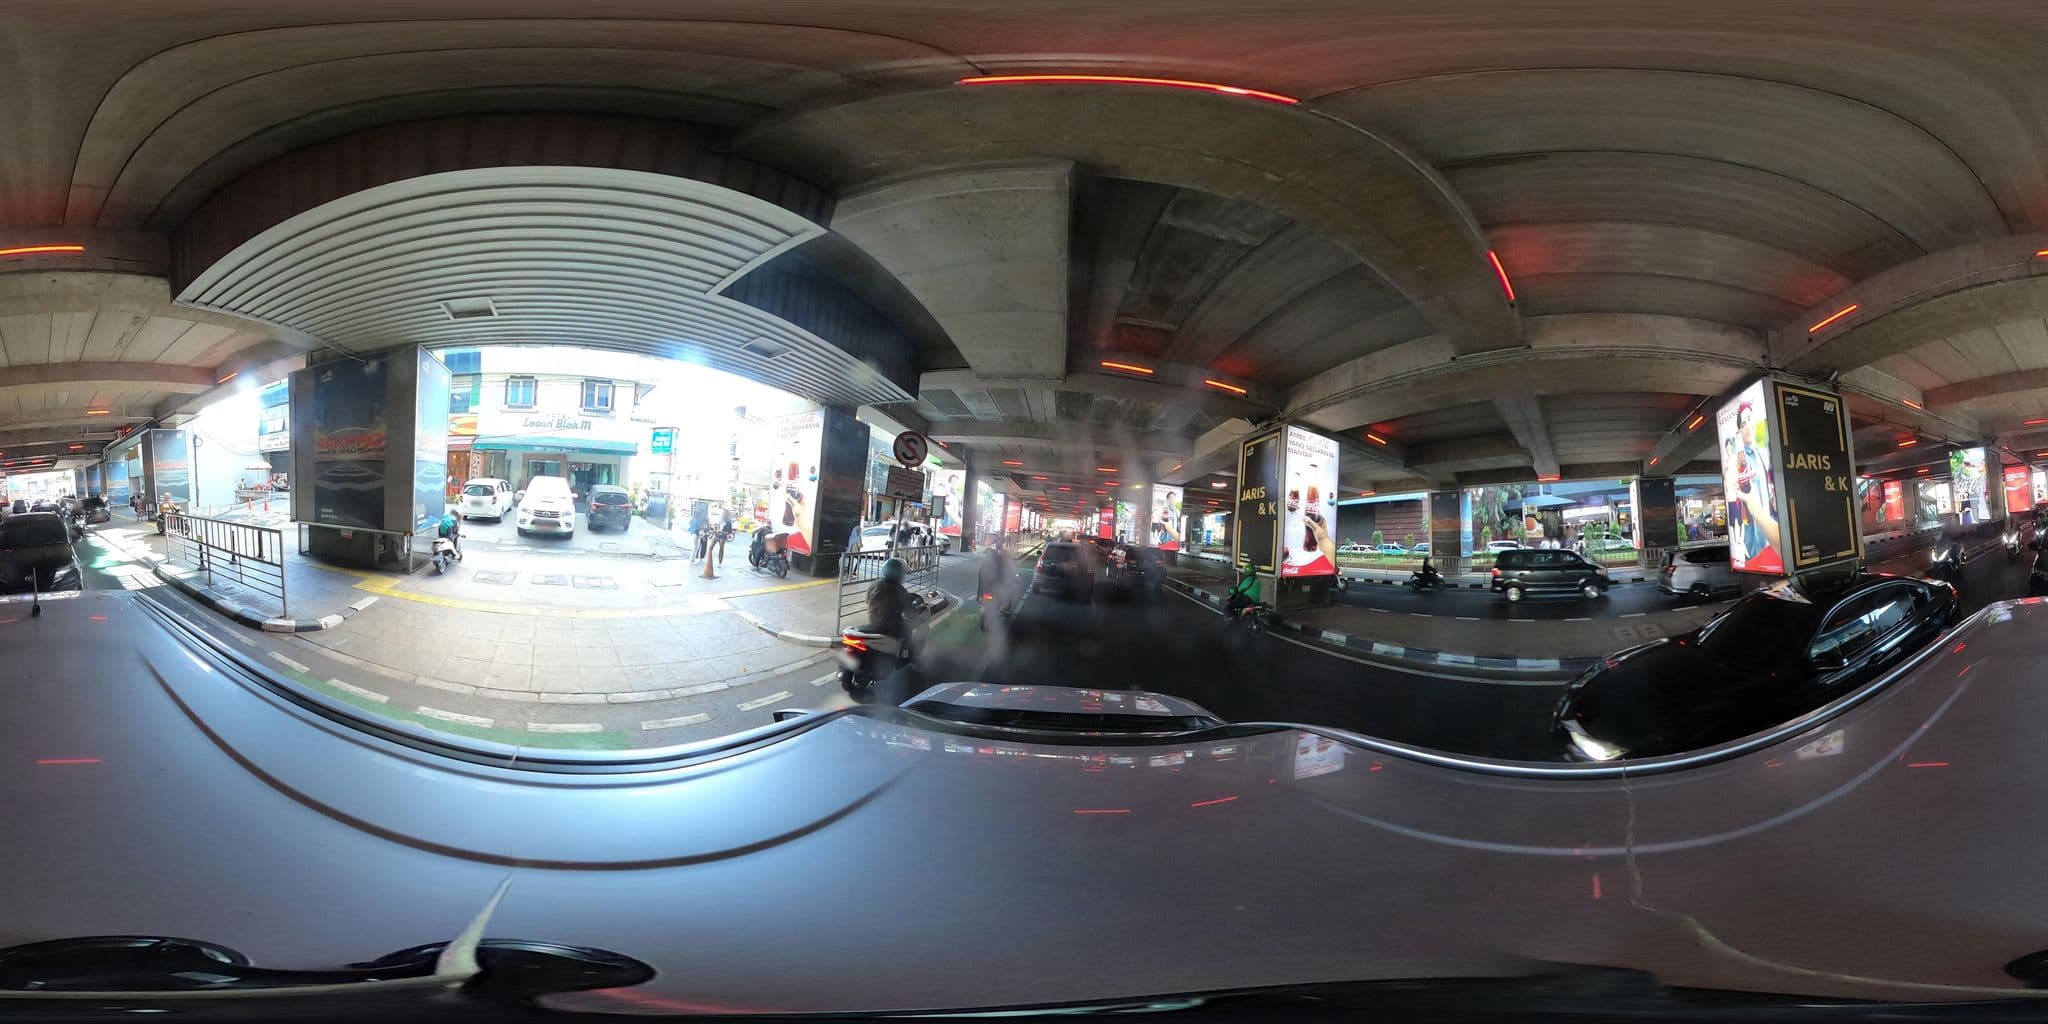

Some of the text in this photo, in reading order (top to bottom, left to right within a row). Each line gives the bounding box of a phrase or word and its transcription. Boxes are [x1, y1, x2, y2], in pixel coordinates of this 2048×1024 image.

[902, 438, 918, 460] S
[1787, 453, 1831, 471] JARIS
[1824, 475, 1849, 491] & K
[1241, 486, 1265, 502] JARIS
[1258, 502, 1266, 516] &
[1269, 501, 1277, 515] K
